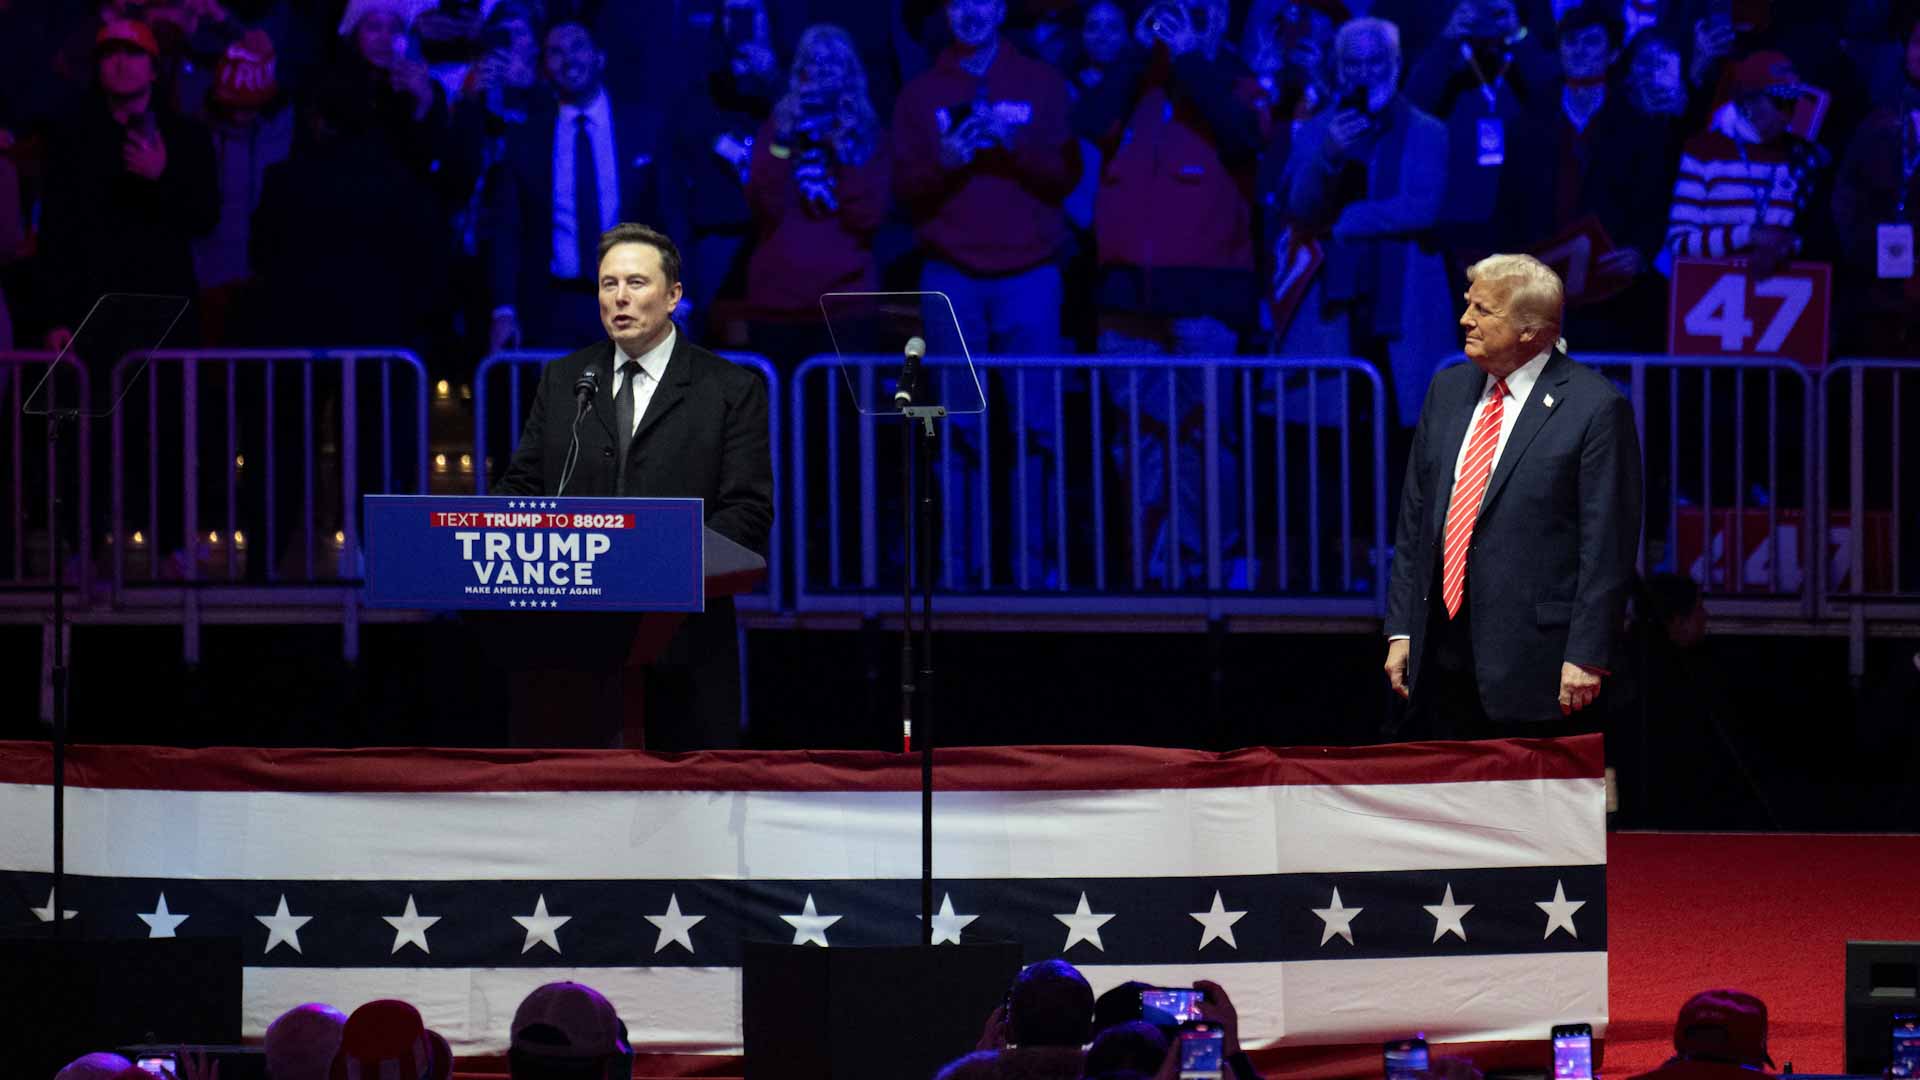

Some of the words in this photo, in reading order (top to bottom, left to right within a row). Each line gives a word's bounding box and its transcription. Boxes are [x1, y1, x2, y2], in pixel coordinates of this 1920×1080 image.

[1683, 272, 1814, 352] 47
[438, 512, 479, 526] TEXT
[483, 513, 542, 527] TRUMP
[547, 514, 569, 528] TO
[572, 514, 625, 529] 88022
[455, 532, 610, 561] TRUMP
[472, 561, 593, 585] VANCE
[464, 586, 491, 594] MAKE
[493, 586, 535, 595] AMERICA
[537, 587, 566, 595] GREAT
[568, 587, 602, 596] AGAIN!
